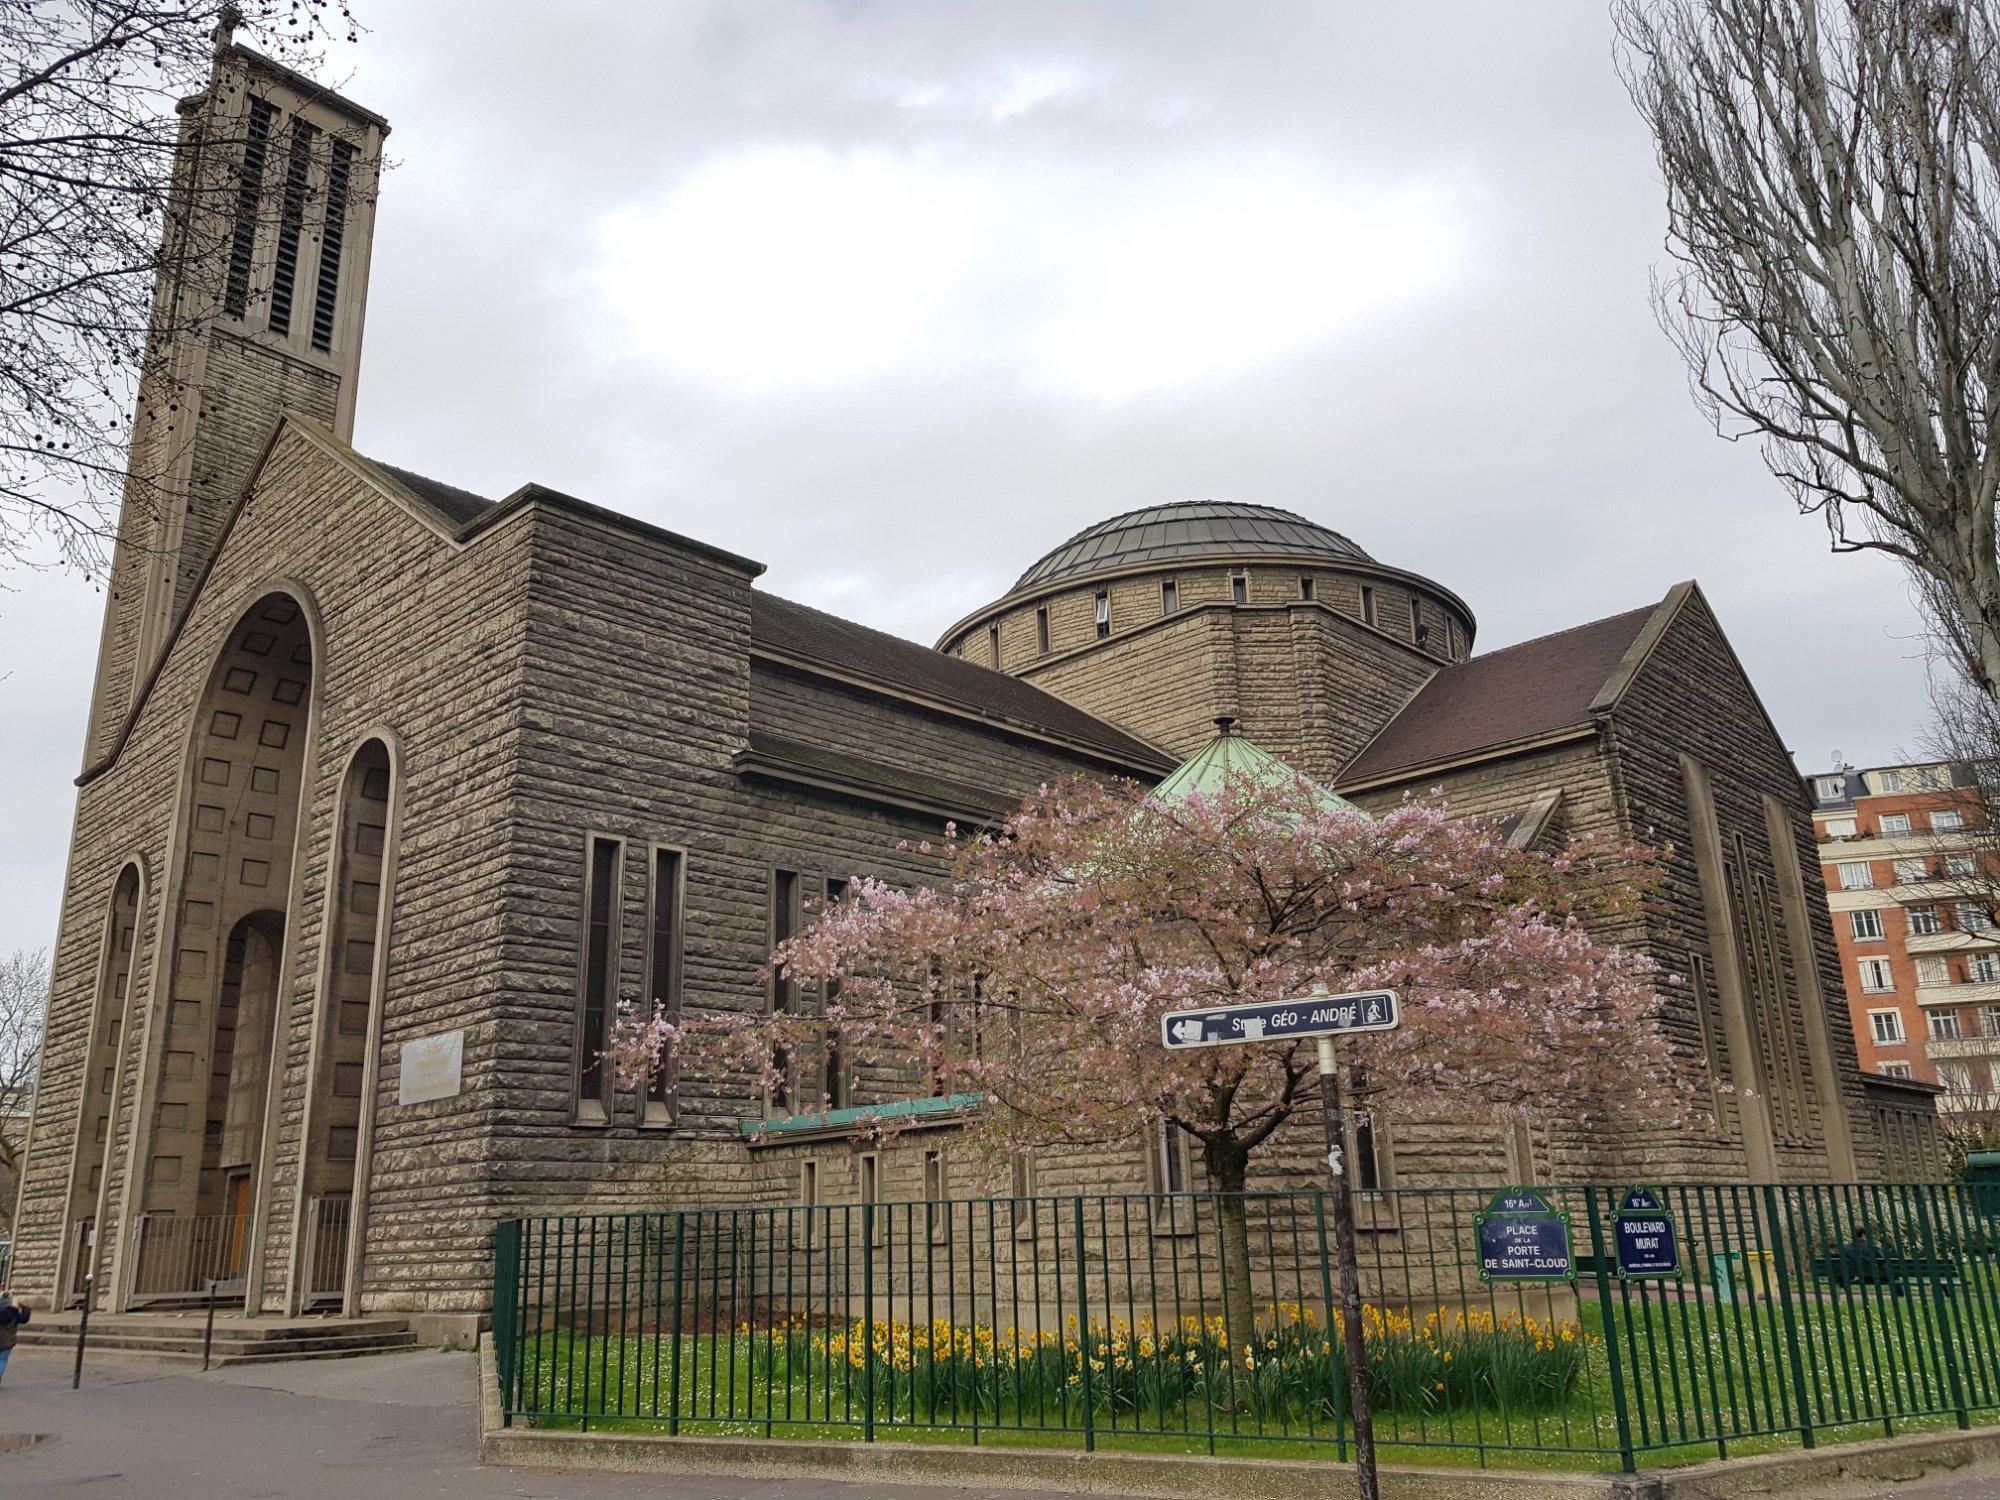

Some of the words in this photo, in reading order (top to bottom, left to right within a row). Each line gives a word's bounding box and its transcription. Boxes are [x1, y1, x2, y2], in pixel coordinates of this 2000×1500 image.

[1232, 1016, 1267, 1031] Ste
[1271, 1010, 1298, 1027] GÉO
[1310, 1002, 1357, 1024] ANDRÉ
[1506, 1225, 1539, 1235] PLACE
[1624, 1221, 1665, 1234] BOULEVARD
[1635, 1237, 1659, 1250] MURAT
[1507, 1246, 1541, 1255] PORTE
[1484, 1259, 1499, 1269] DE
[1501, 1258, 1568, 1269] SAINT-CLOUD
